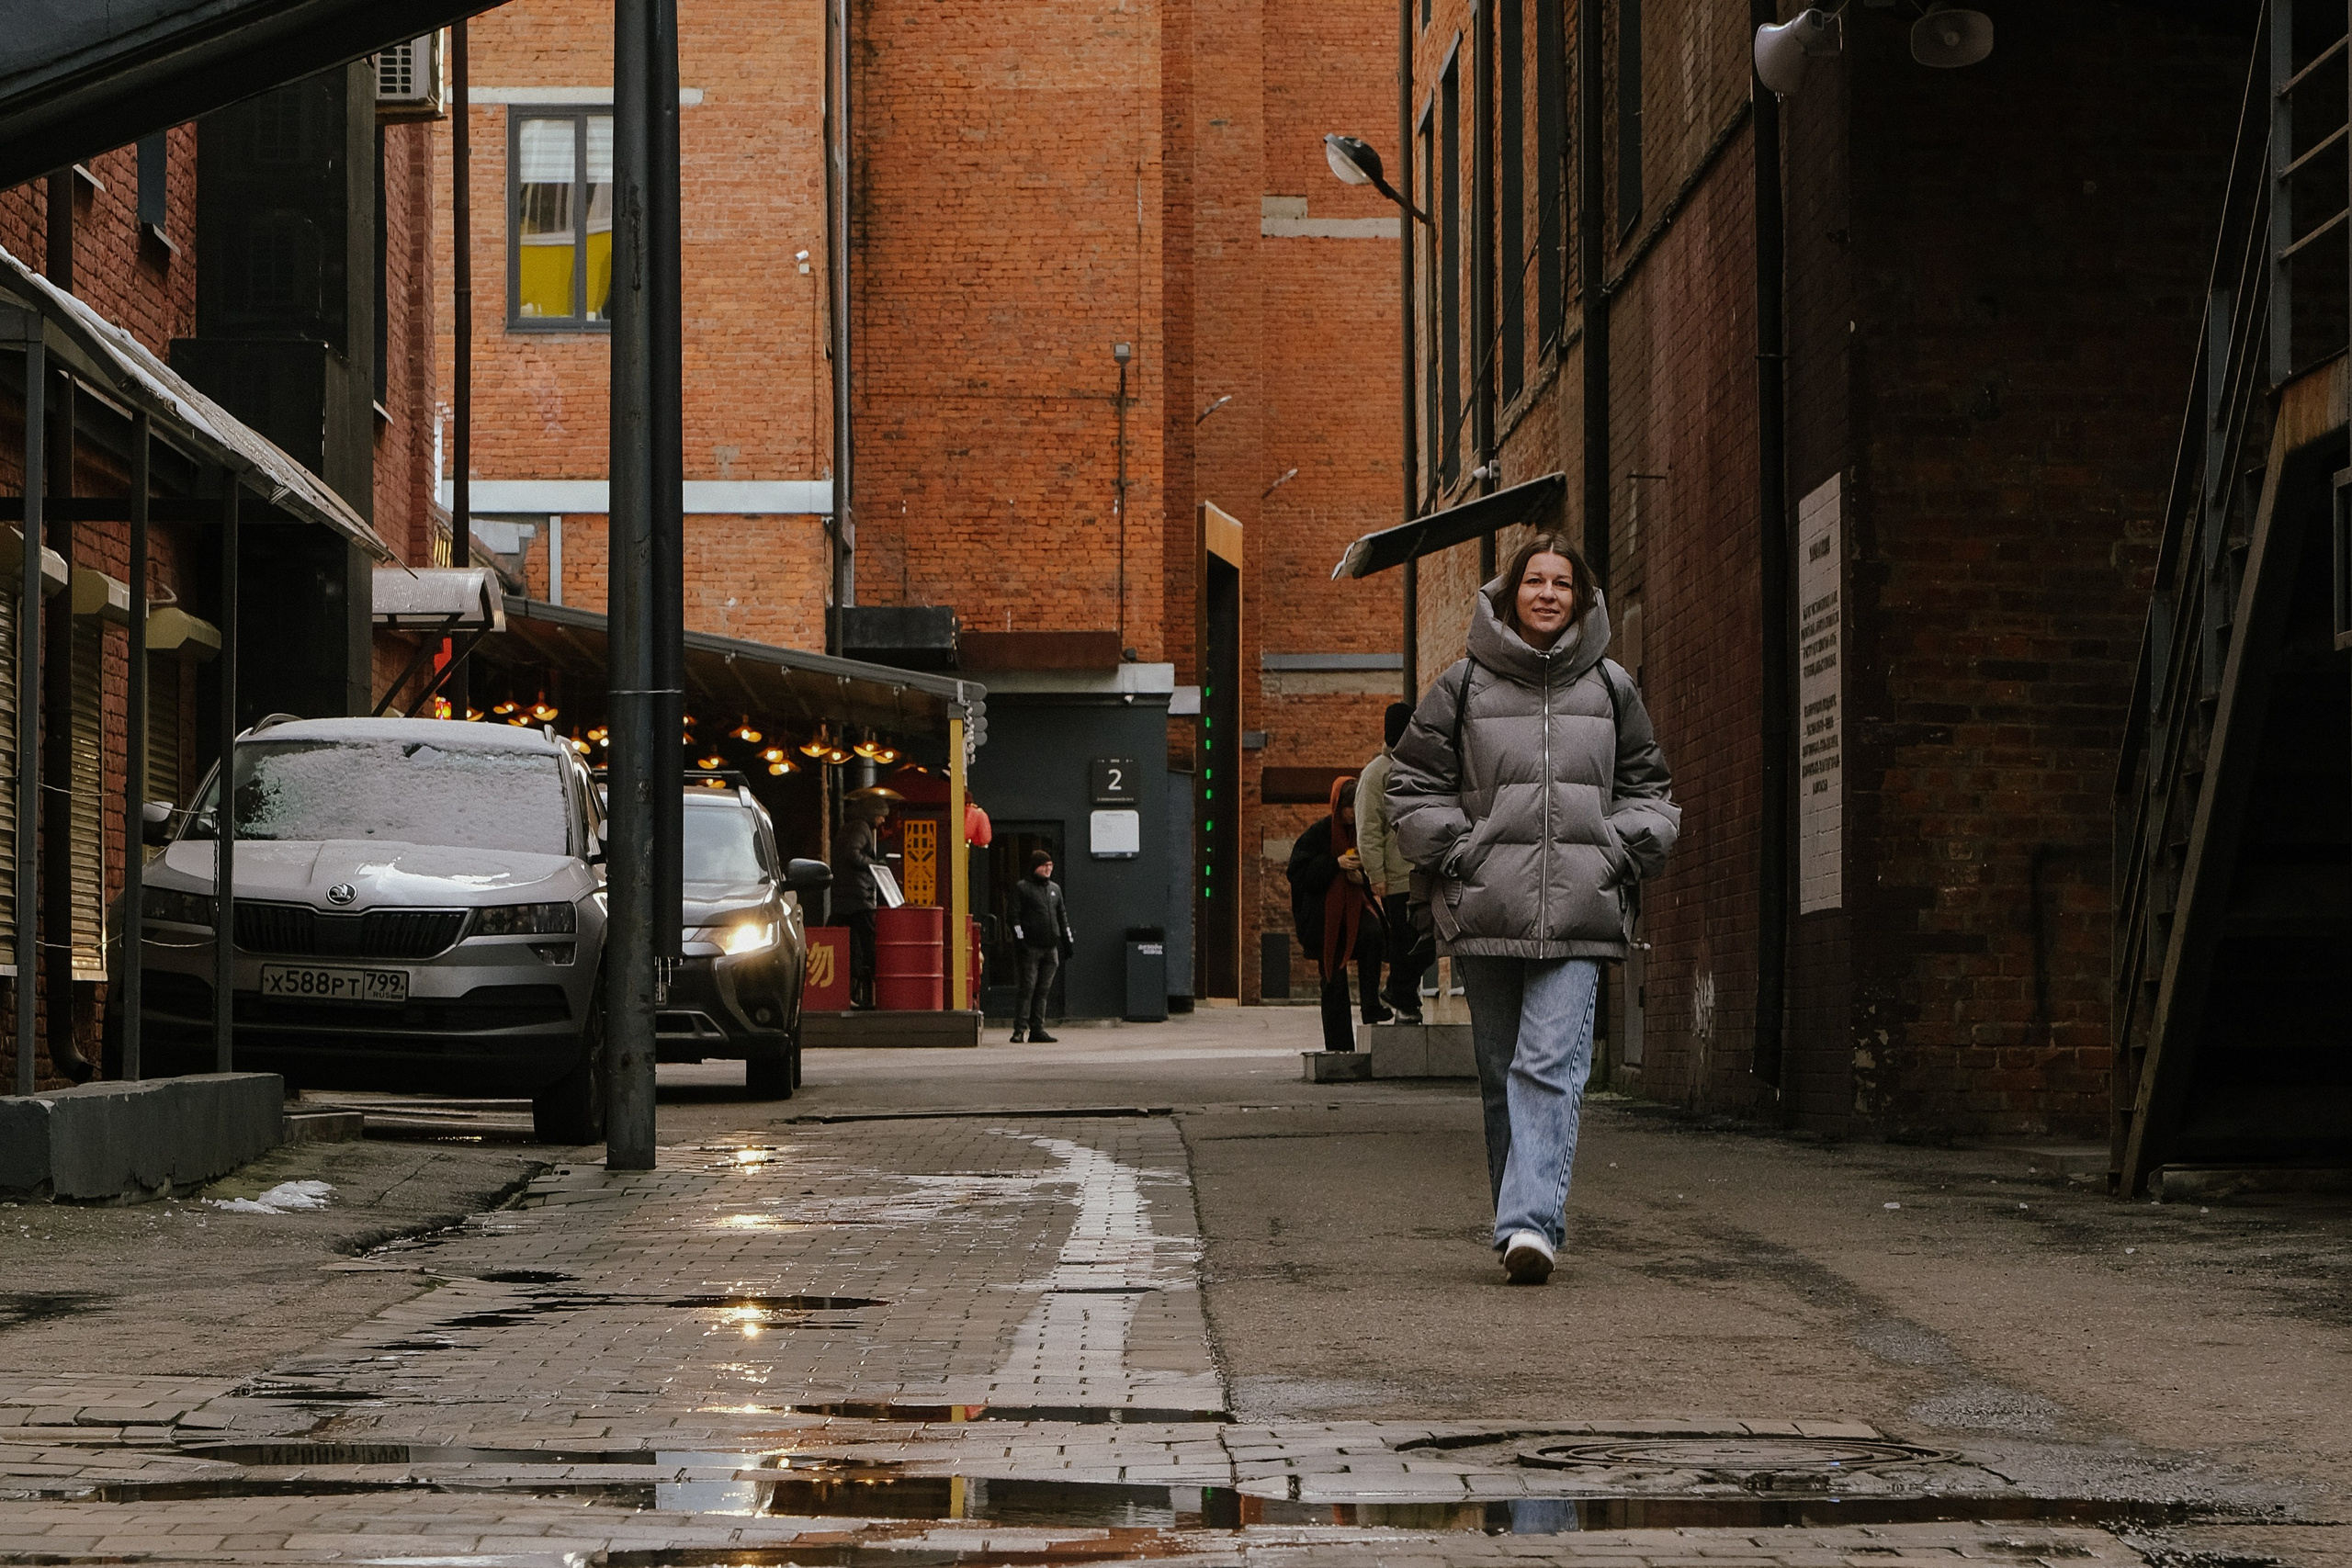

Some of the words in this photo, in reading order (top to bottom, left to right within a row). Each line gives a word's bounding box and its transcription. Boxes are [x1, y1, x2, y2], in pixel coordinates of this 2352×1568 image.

[1108, 768, 1122, 790] 2
[366, 973, 401, 992] 799
[372, 991, 390, 999] RUS
